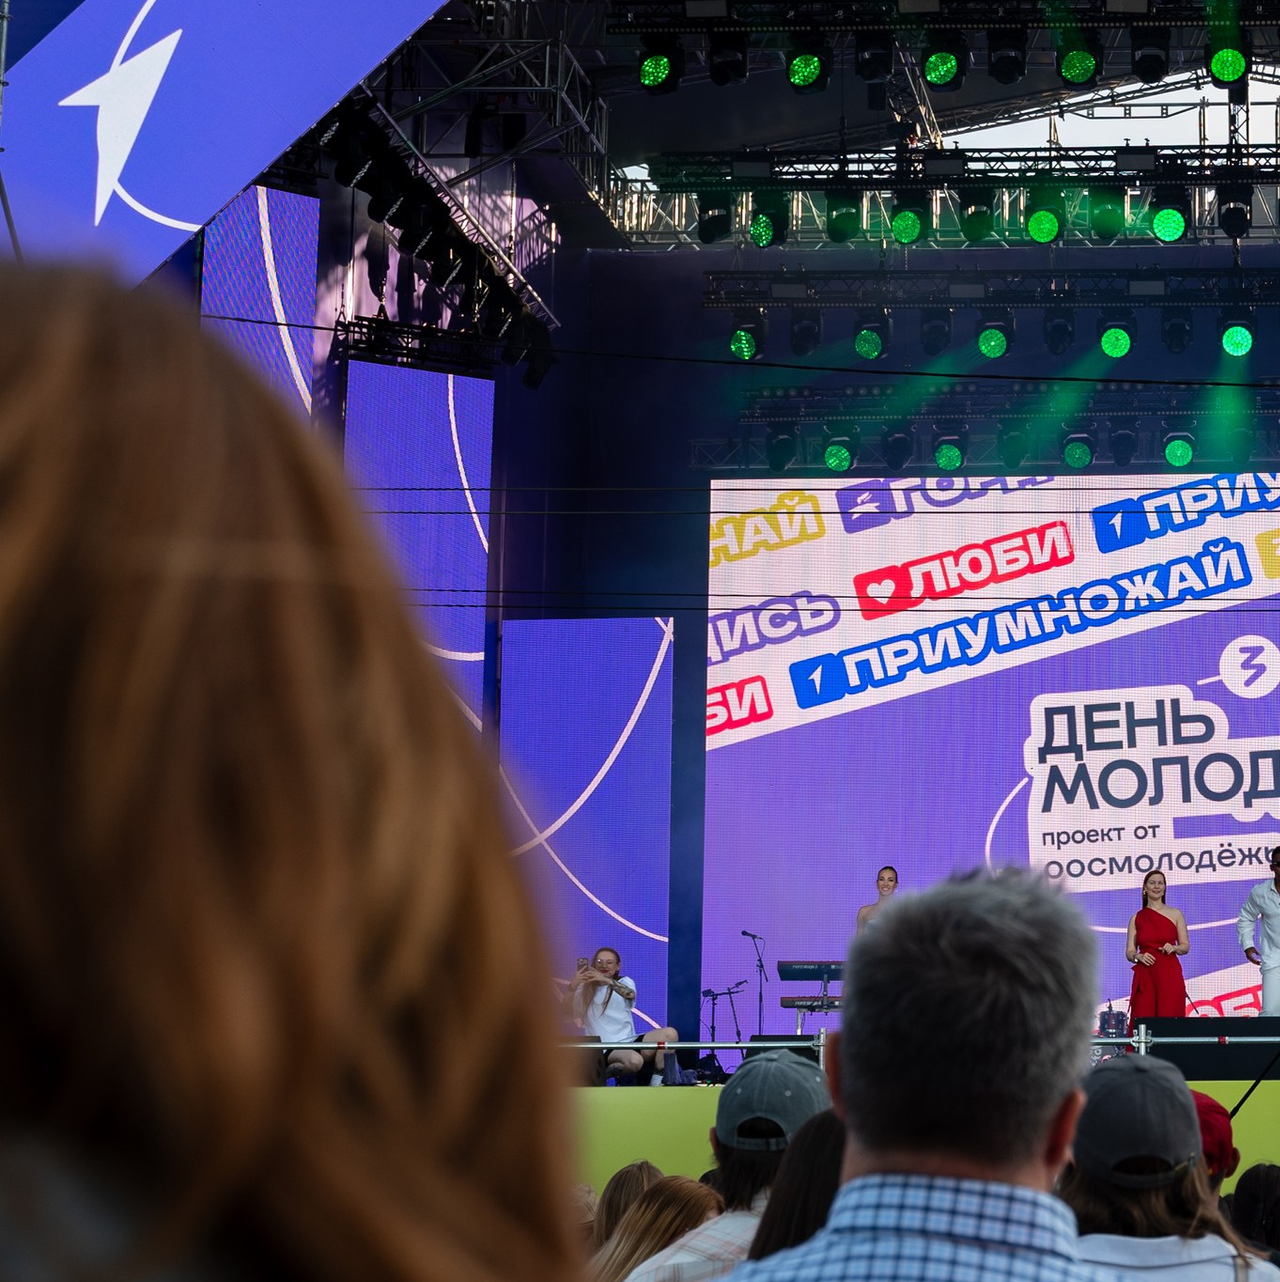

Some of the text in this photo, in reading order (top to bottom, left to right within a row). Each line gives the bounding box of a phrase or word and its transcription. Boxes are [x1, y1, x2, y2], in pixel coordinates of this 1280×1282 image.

[907, 525, 1071, 599] ЛЮБИ
[842, 543, 1245, 688] ПРИУМНОЖАЙ
[1038, 698, 1215, 763] ДЕНЬ
[1042, 824, 1161, 851] проект от
